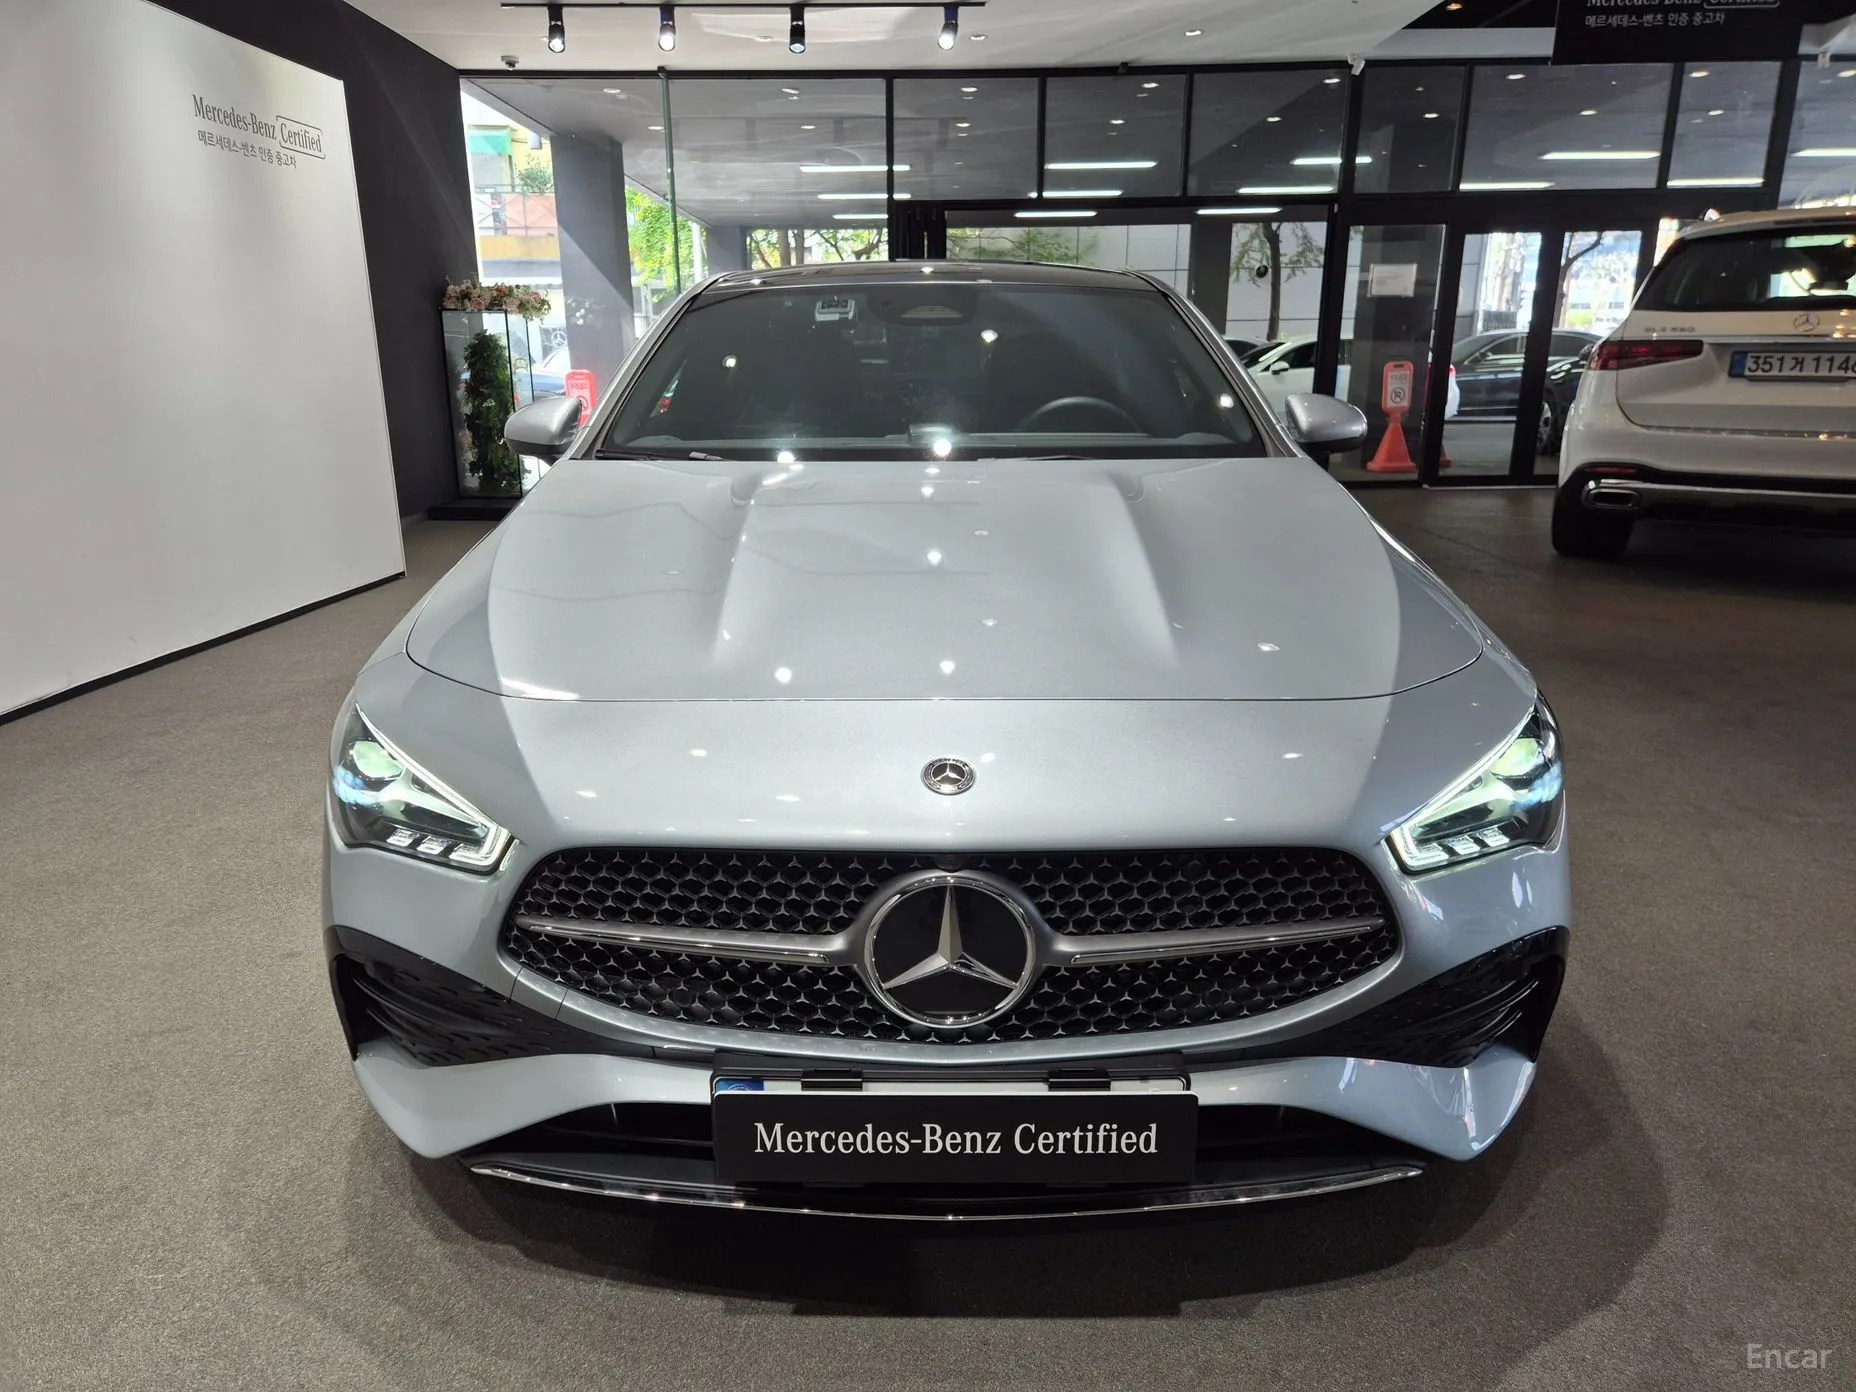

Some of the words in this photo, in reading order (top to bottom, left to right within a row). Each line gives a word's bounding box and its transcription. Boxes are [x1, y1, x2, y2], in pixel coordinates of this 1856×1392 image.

[1585, 13, 1664, 28] 메르세데스-벤츠
[1668, 12, 1689, 26] 인증
[1692, 11, 1725, 26] 중고차
[192, 94, 277, 140] Mercedes-Benz
[280, 122, 322, 153] Certified
[258, 147, 274, 164] 인증
[275, 151, 297, 169] 중고차
[753, 1121, 1002, 1155] Mercedes-Benz
[1014, 1122, 1159, 1154] Certified
